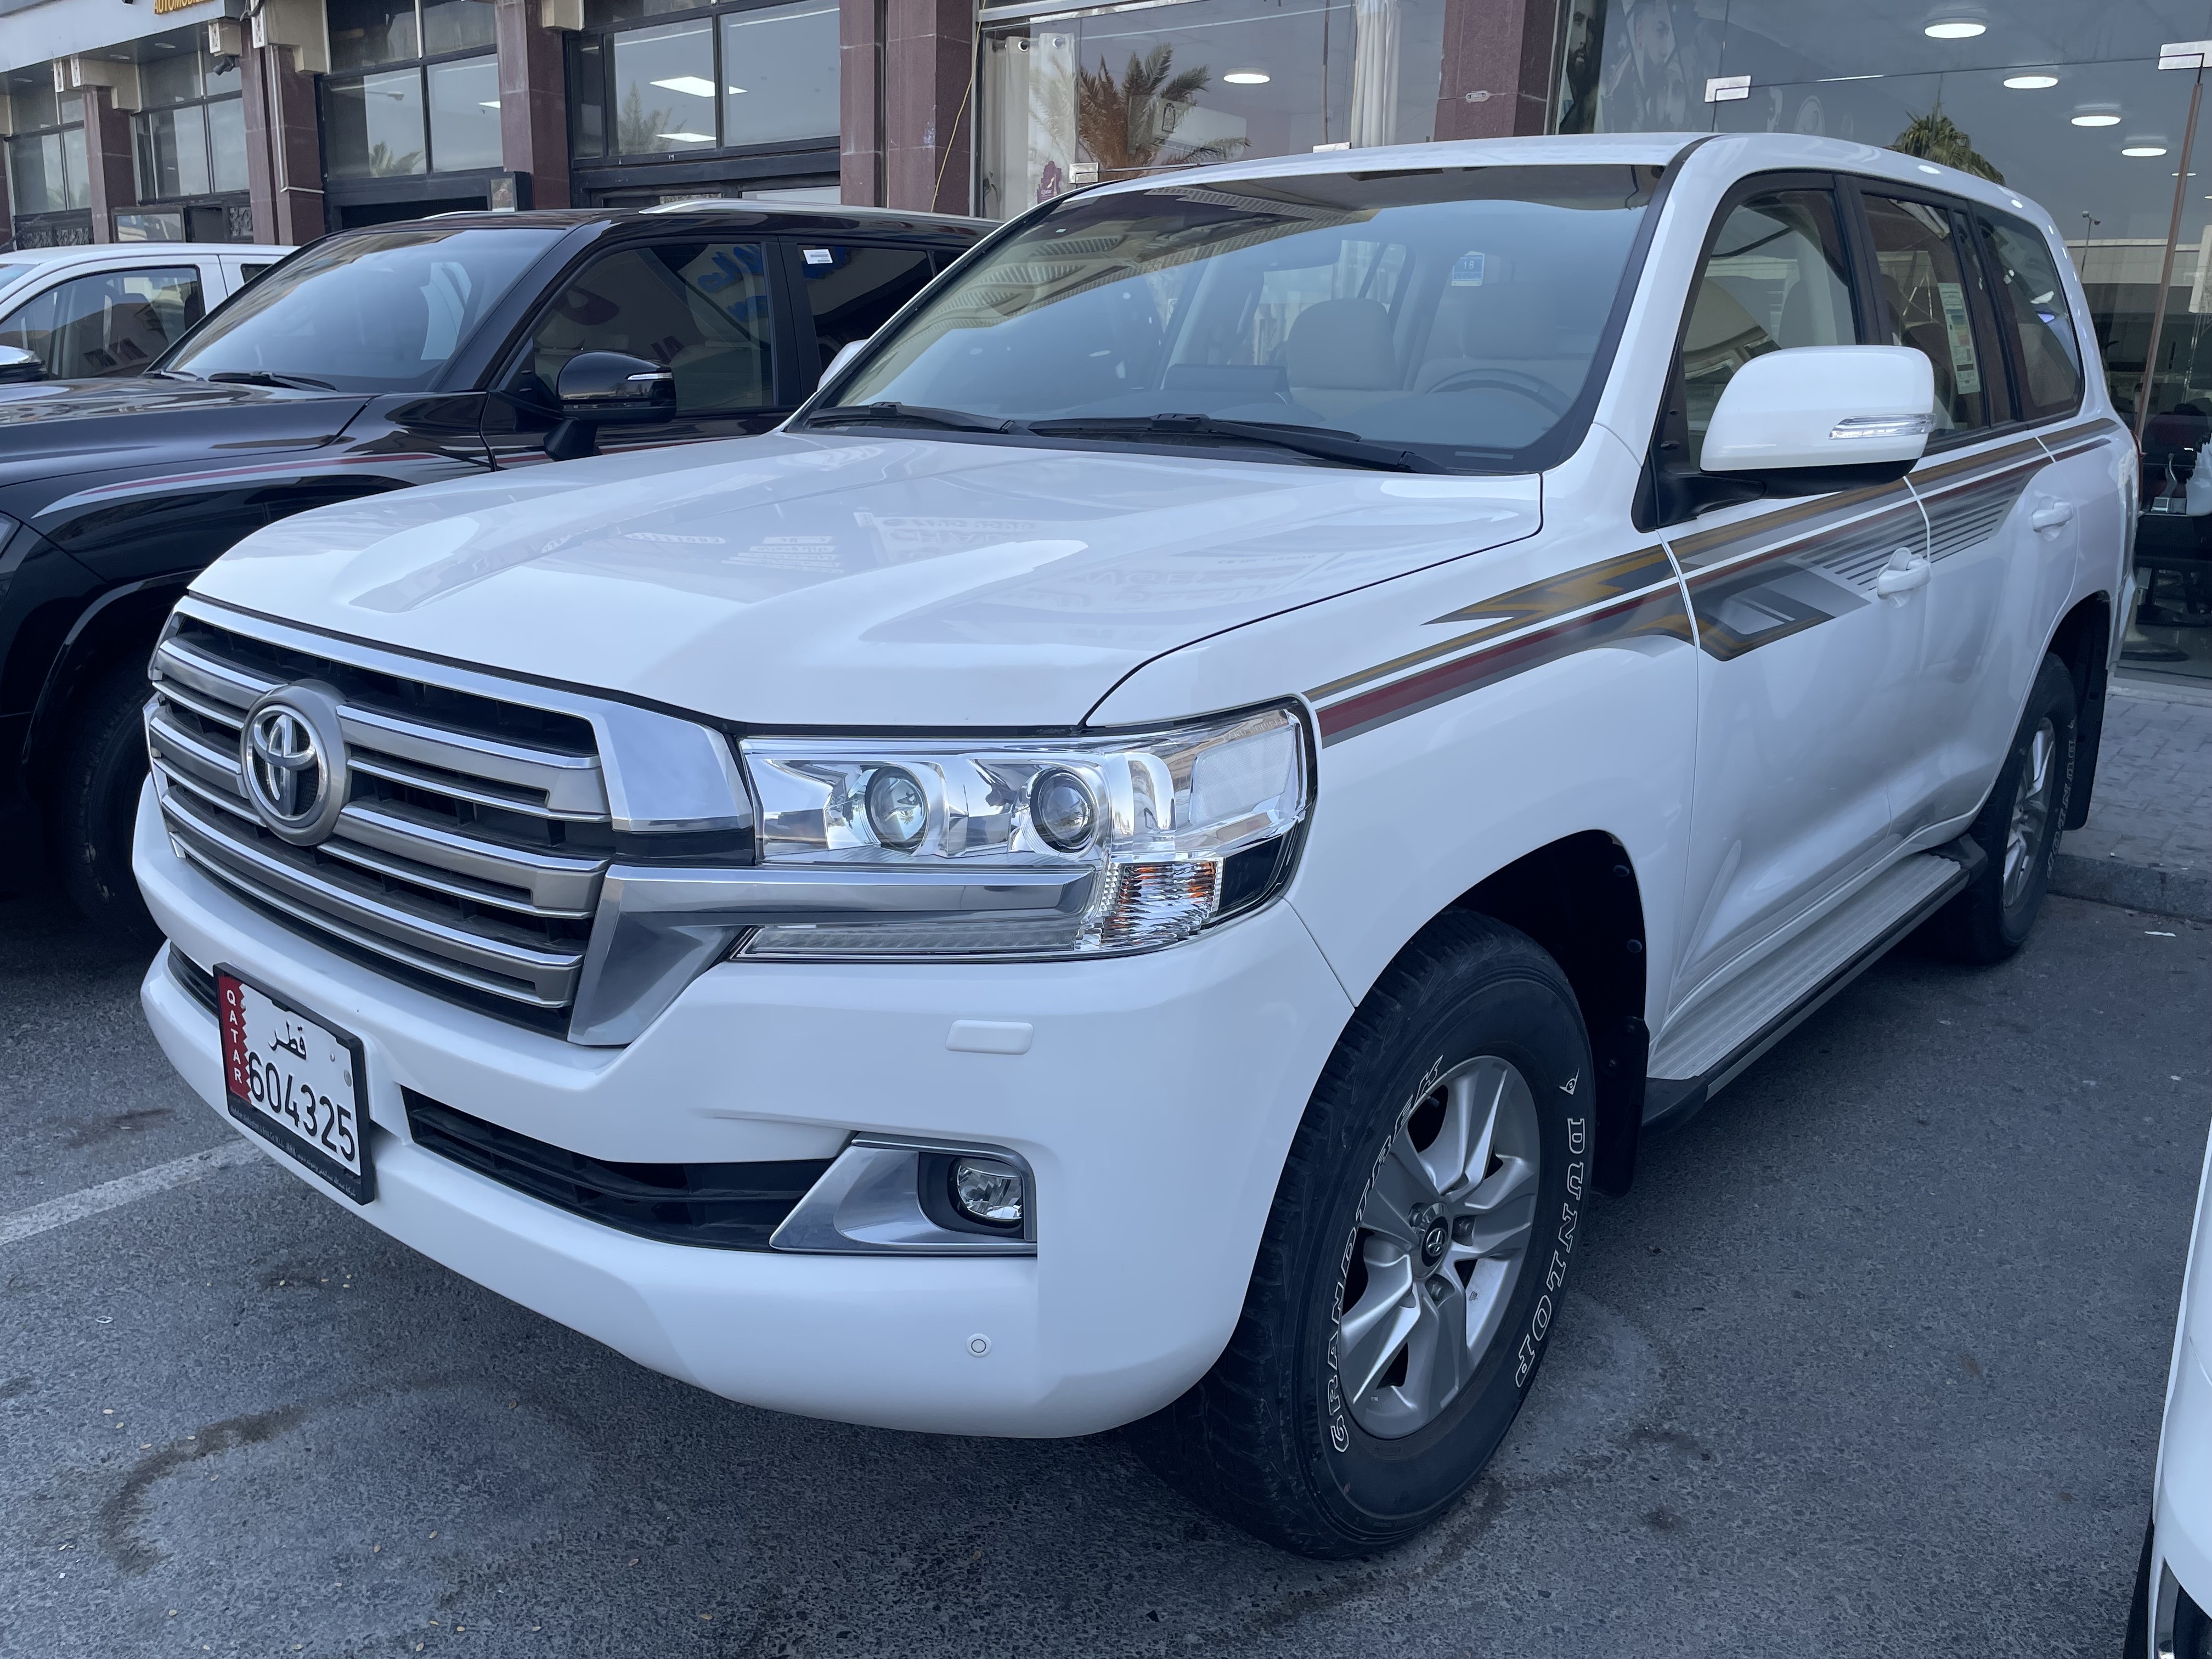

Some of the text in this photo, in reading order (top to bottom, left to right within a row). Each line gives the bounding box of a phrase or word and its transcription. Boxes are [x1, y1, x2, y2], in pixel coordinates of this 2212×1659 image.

[154, 0, 204, 14] AUTOM
[1464, 260, 1475, 270] 18
[2047, 740, 2076, 879] DUNLOP
[226, 989, 243, 1084] QATAR
[268, 1019, 307, 1061] قطر
[249, 1051, 356, 1162] 604325
[1515, 1118, 1585, 1388] DUNLOP
